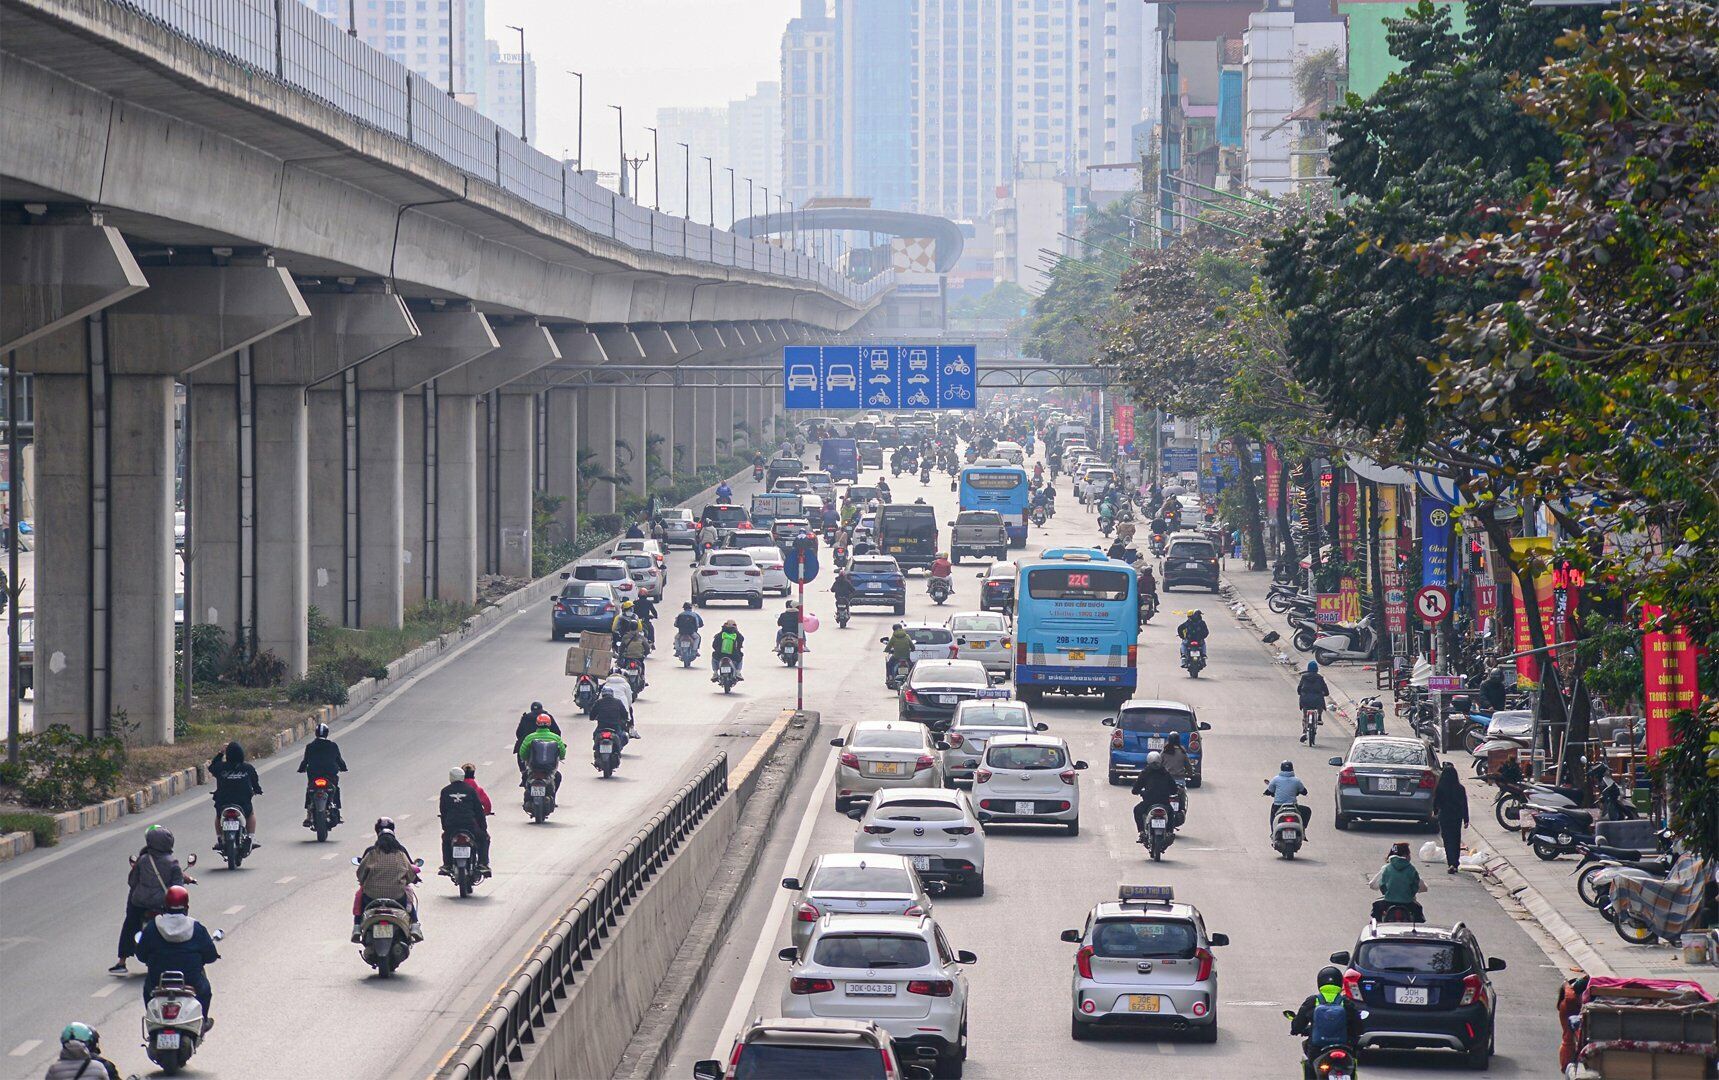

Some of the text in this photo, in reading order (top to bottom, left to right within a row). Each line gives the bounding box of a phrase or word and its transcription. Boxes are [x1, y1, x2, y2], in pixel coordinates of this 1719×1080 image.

[1068, 574, 1090, 587] 22C
[1482, 588, 1493, 604] LÝ
[1318, 611, 1338, 621] PHÁT
[1649, 692, 1666, 702] TRONG
[850, 984, 892, 992] 30K-043.38
